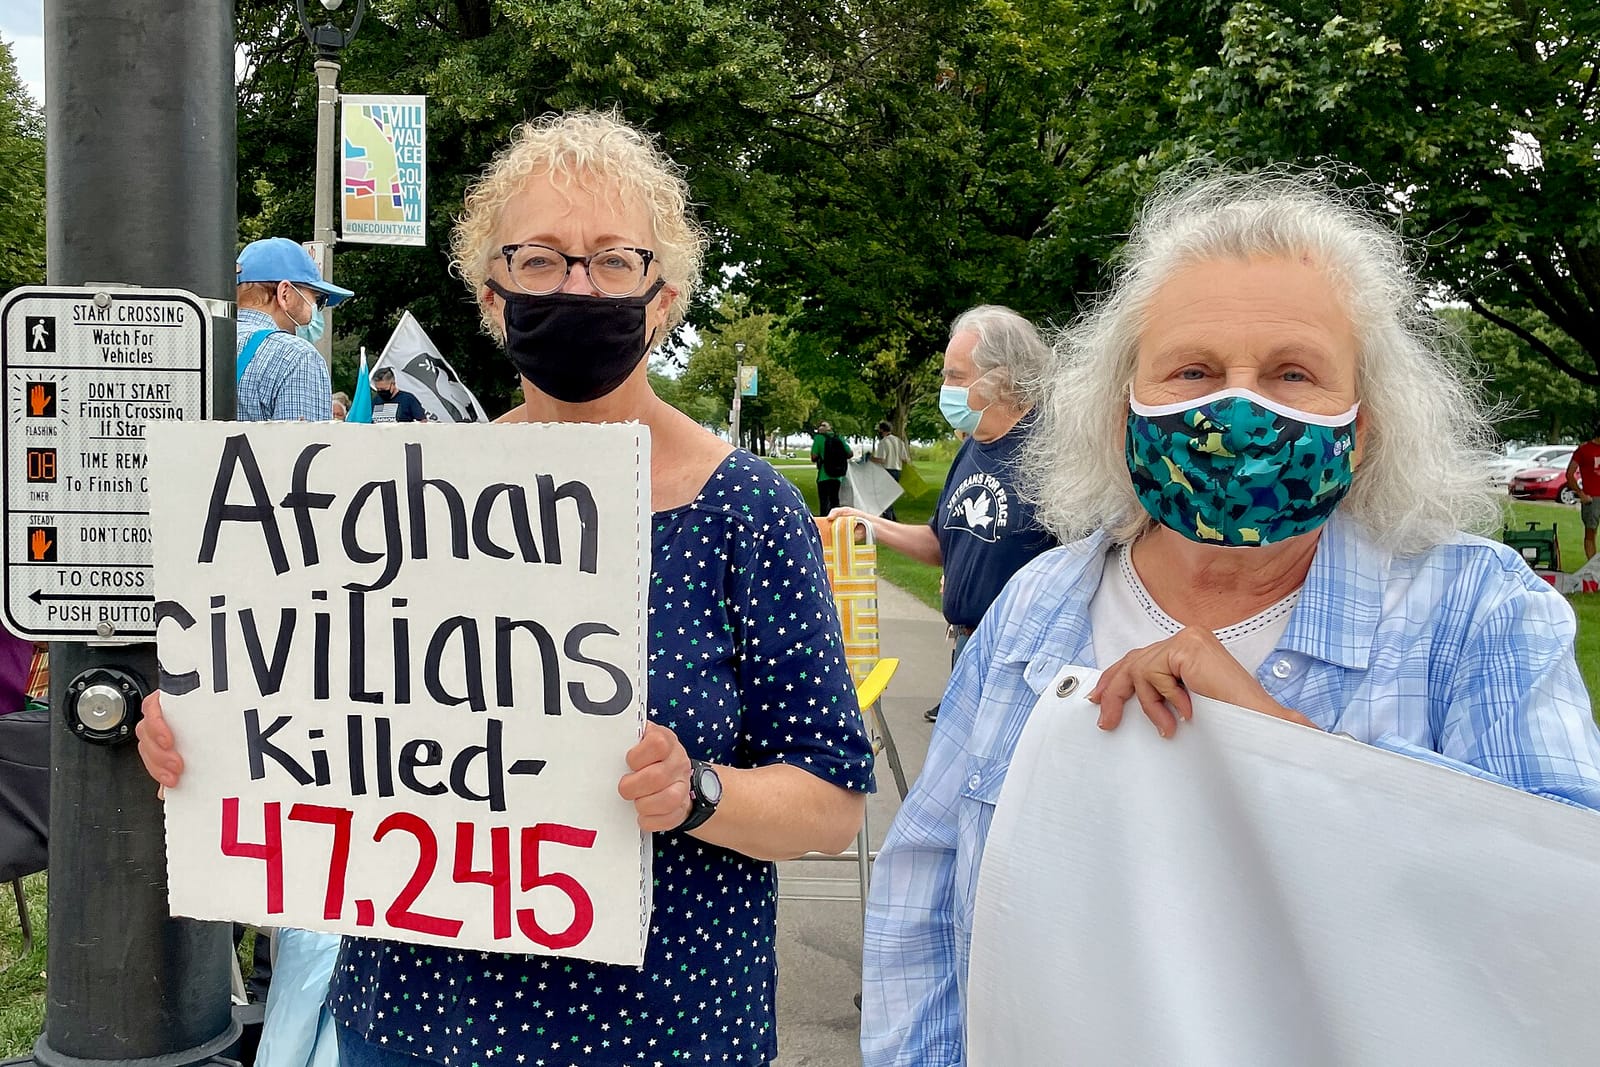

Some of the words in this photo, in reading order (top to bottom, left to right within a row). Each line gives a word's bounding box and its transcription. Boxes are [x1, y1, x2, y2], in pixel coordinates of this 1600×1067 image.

[346, 222, 421, 235] #ONECOUNTYMKE
[118, 306, 184, 323] CROSSING
[93, 329, 130, 346] Watch
[134, 330, 154, 346] For
[102, 348, 153, 364] Vehicles
[89, 383, 126, 399] DON'T
[131, 383, 171, 400] START
[80, 402, 120, 418] Finish
[125, 403, 184, 421] Crossing
[26, 426, 58, 436] FLASHING
[101, 421, 111, 436] If
[116, 421, 146, 437] Star
[80, 452, 108, 468] TIME
[116, 453, 148, 469] REMA
[66, 476, 81, 491] To
[89, 477, 133, 493] Finish
[30, 491, 49, 501] TIMER
[947, 473, 984, 509] VETERANS
[983, 475, 1000, 492] FOR
[995, 488, 1008, 527] PEACE
[198, 433, 599, 590] Afghan
[30, 515, 55, 525] STEADY
[80, 527, 118, 543] DON'T
[57, 571, 82, 586] TO
[90, 571, 145, 587] CROSS
[48, 606, 91, 621] PUSH
